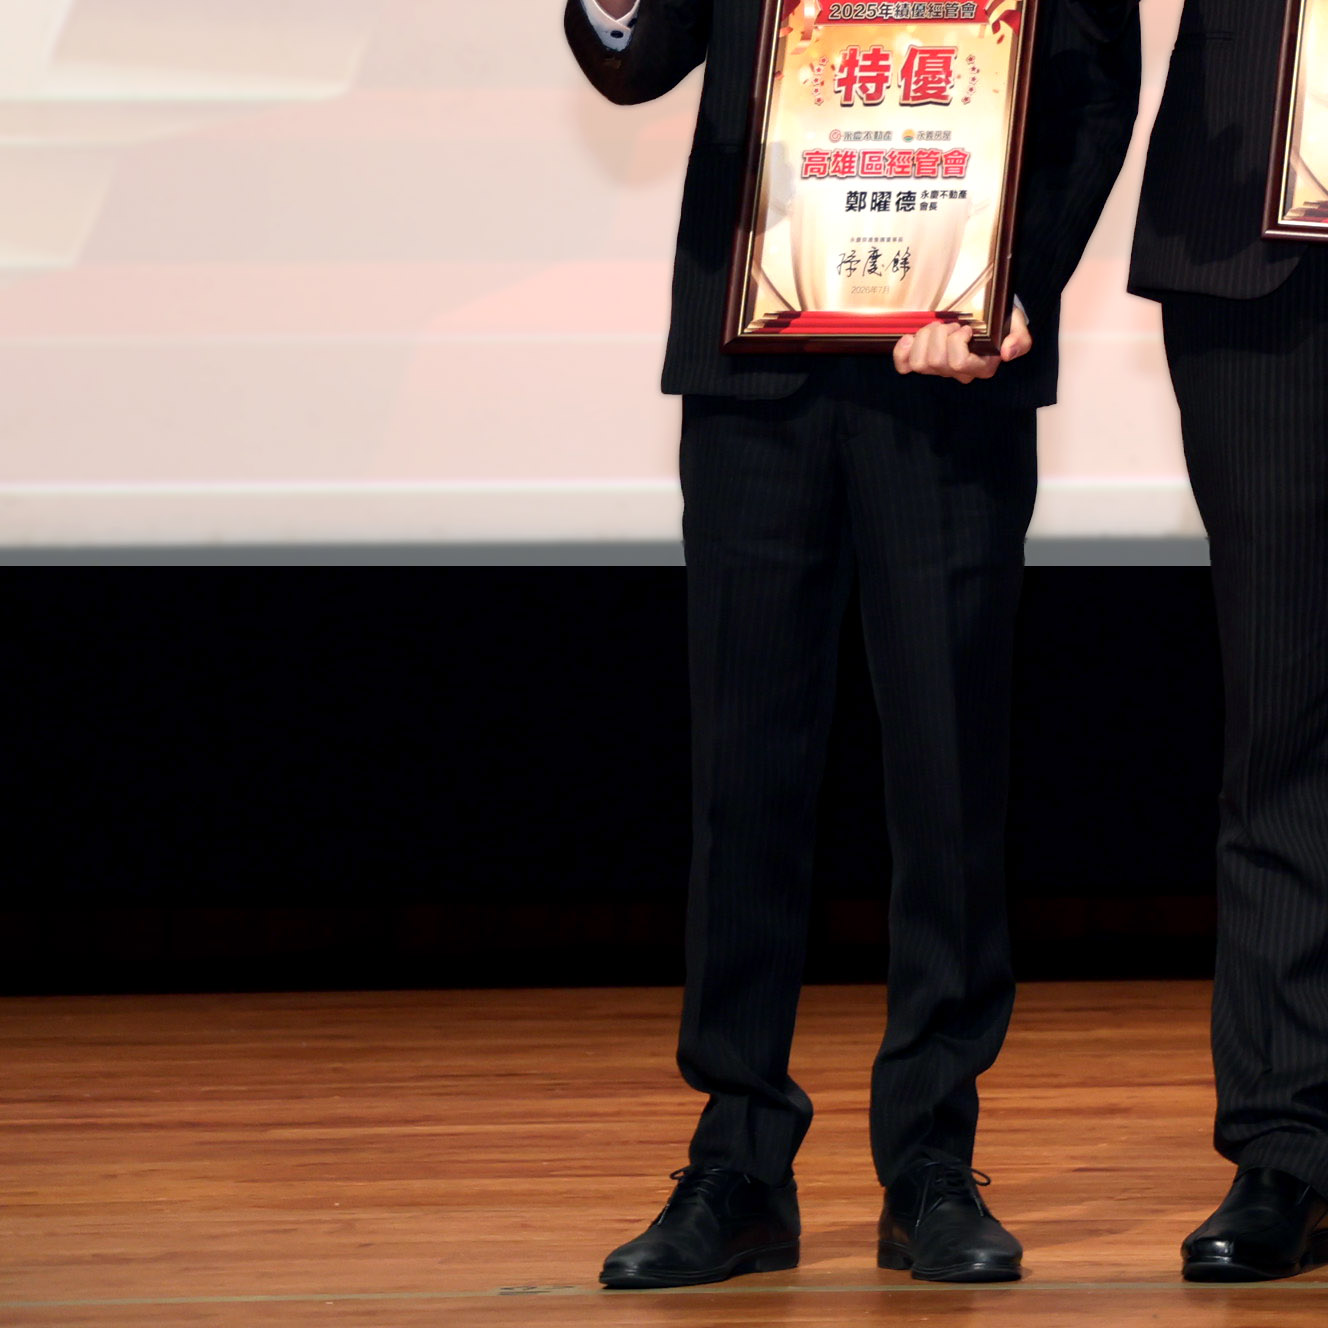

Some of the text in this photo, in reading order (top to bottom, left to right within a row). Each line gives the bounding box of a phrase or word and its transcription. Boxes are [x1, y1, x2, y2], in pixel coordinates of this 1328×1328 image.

[829, 2, 977, 20] 2025年績優經管會
[834, 45, 957, 106] 特優
[802, 148, 971, 179] 高雄區經管會
